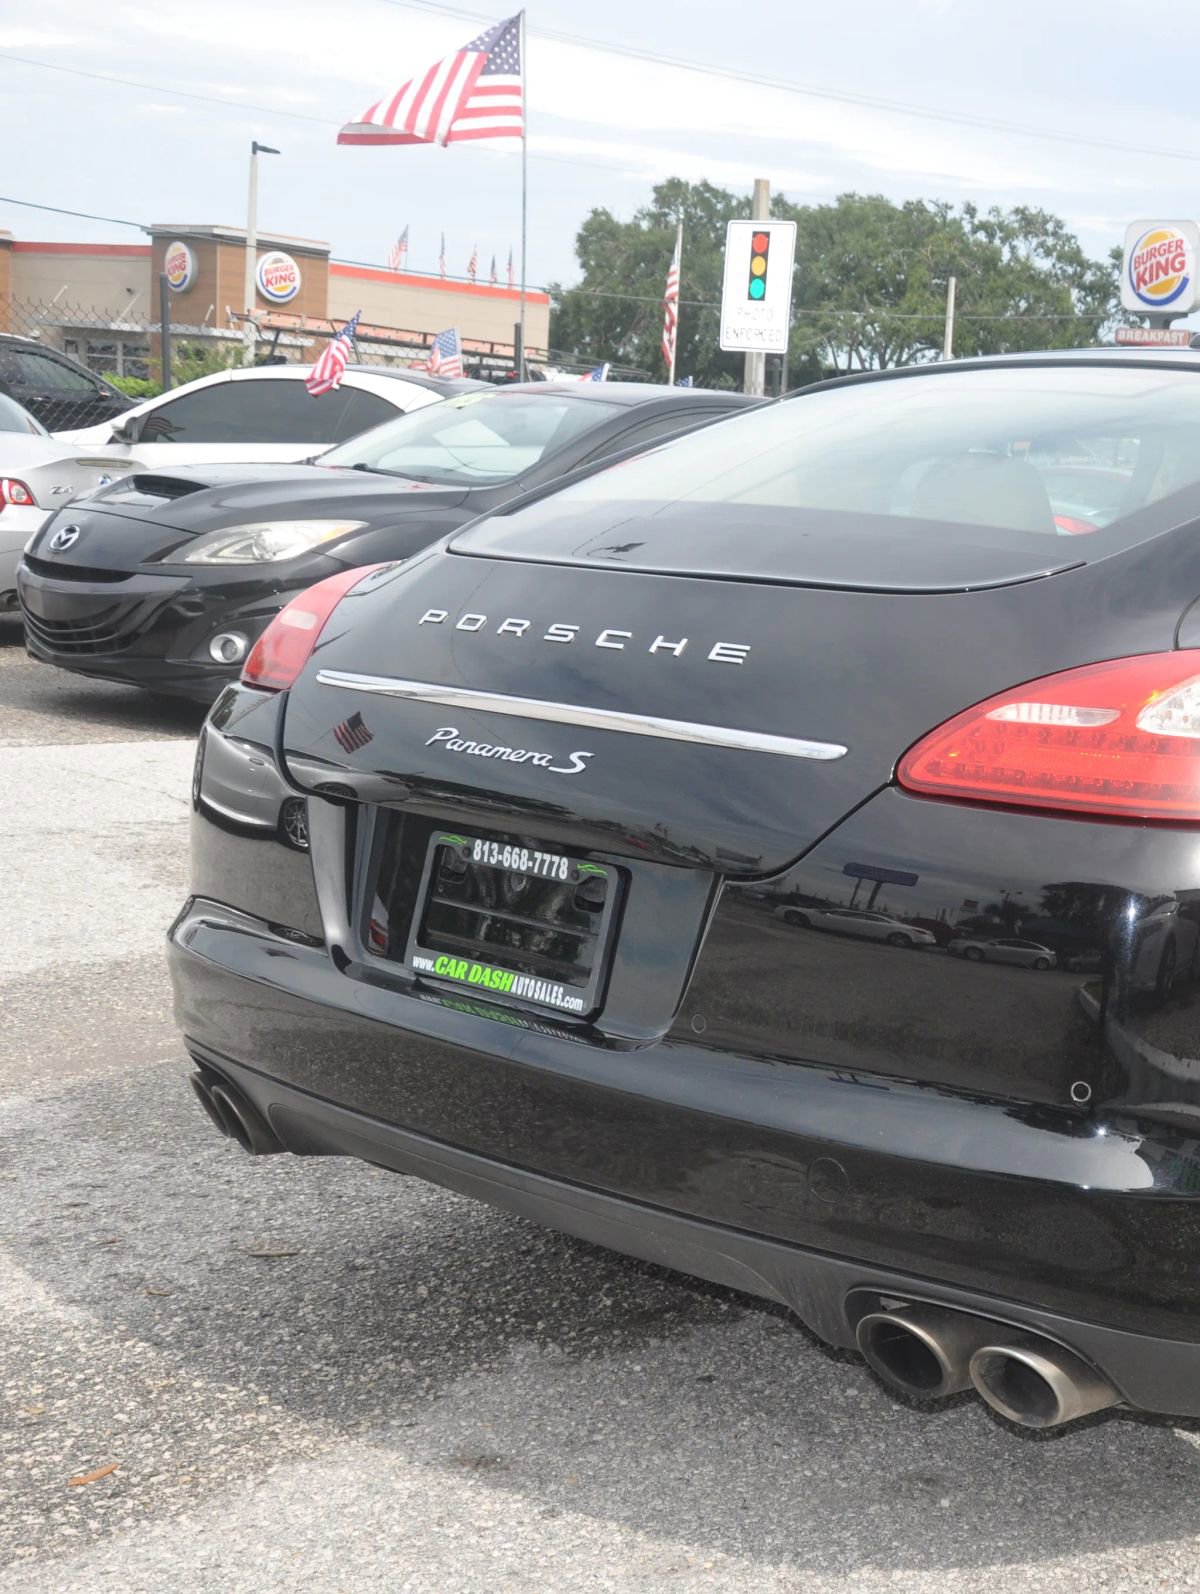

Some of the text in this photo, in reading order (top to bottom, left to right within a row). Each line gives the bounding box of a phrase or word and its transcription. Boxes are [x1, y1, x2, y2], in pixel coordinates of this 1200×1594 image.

[1134, 239, 1184, 271] BURGER
[265, 272, 295, 288] KING
[1136, 252, 1186, 292] KING
[736, 306, 774, 322] PHOTO
[725, 326, 783, 343] ENFORCED
[1118, 329, 1185, 345] BREAKFAST
[418, 609, 751, 664] PORSCHE
[425, 727, 596, 774] Panamera S
[473, 839, 568, 879] 813-668-7778
